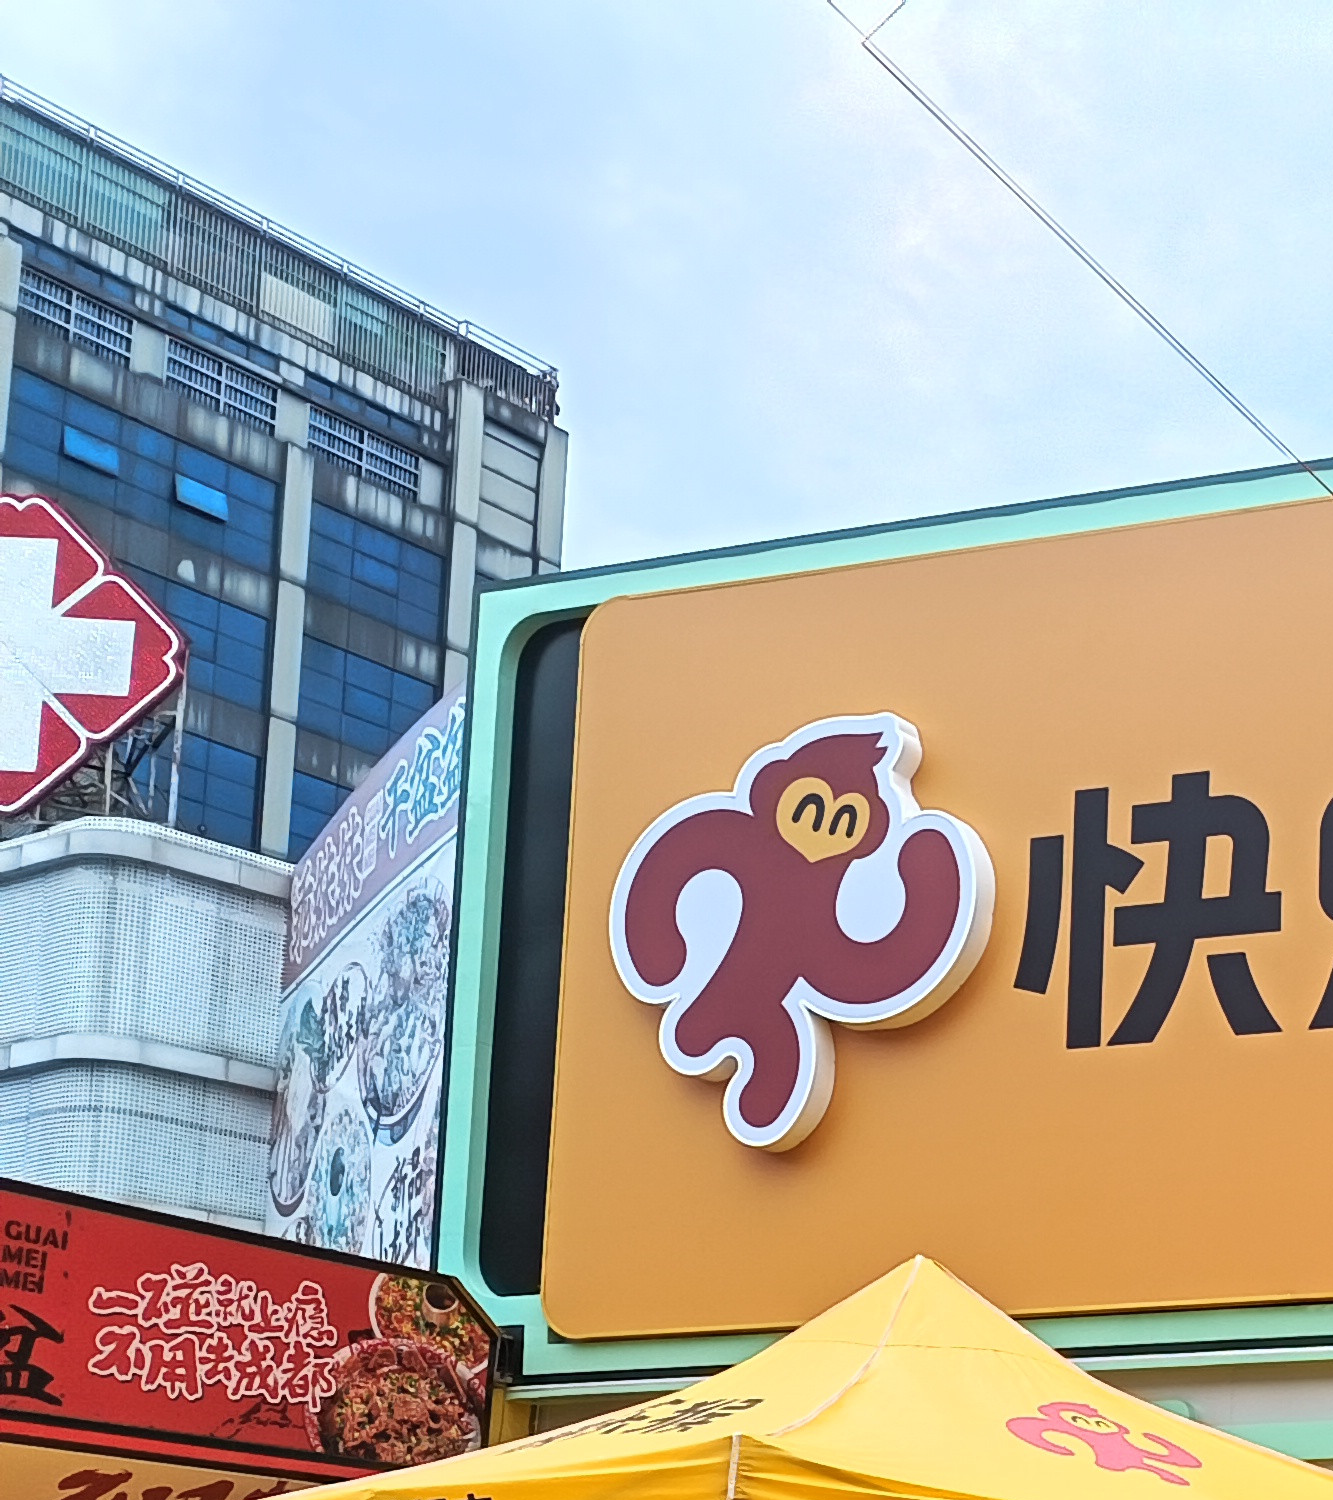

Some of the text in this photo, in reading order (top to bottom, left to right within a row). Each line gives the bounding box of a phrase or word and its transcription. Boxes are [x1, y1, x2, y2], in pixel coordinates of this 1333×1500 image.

[5, 1219, 68, 1251] GUAI
[1, 1244, 48, 1273] MEI
[0, 1268, 45, 1295] MEI
[88, 1326, 336, 1412] 不用去成都
